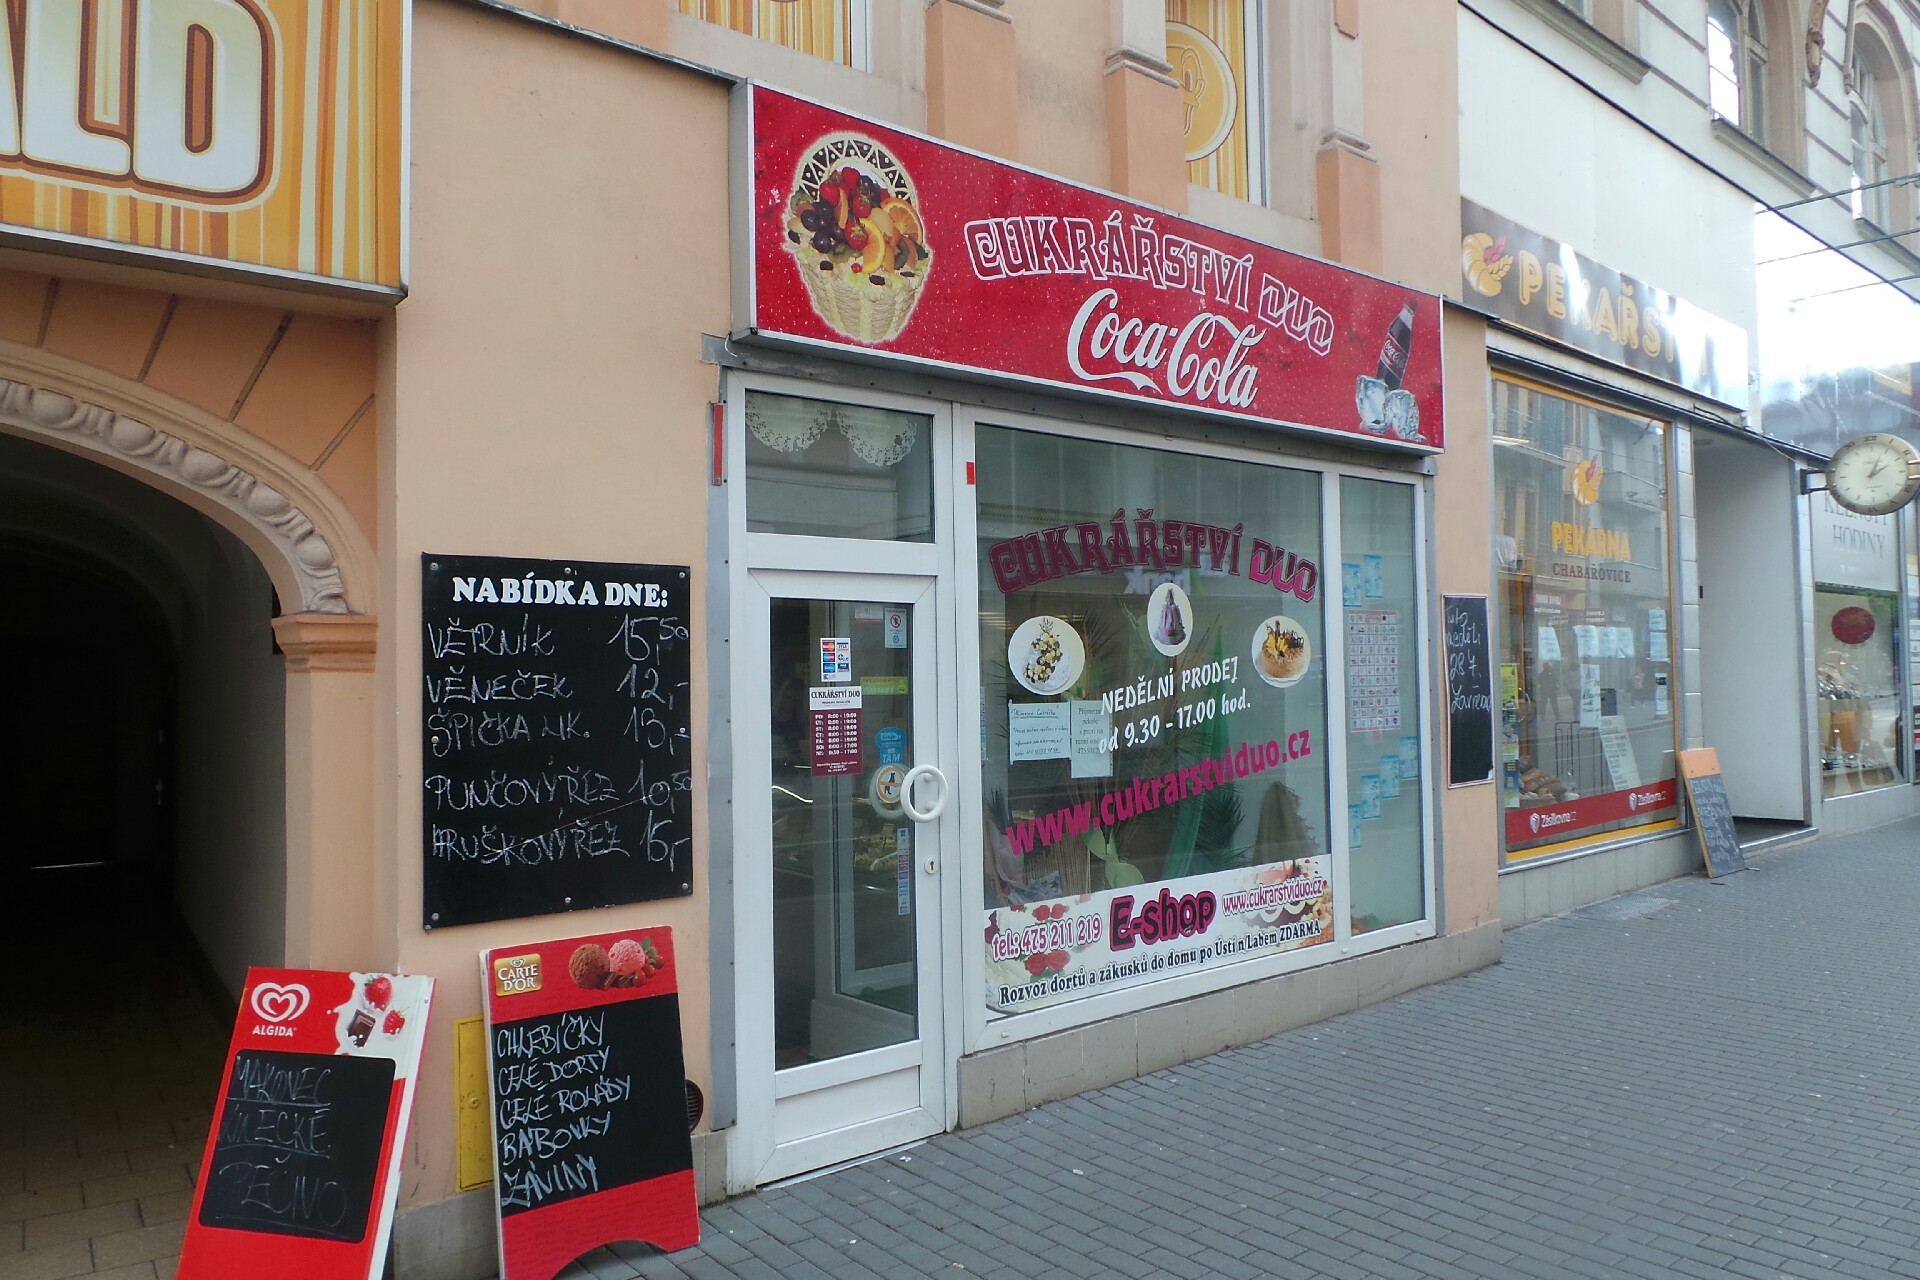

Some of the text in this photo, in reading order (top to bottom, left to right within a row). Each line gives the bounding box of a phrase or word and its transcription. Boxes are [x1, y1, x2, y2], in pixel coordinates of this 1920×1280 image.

[964, 210, 1334, 357] CUKRÁŘSTVÍ DUO
[1518, 249, 1710, 377] PEKAŘST
[1067, 288, 1267, 408] Coca-Cola
[988, 508, 1245, 594] CUKRÁŘSTVÍ
[1249, 538, 1319, 603] DUO
[1551, 519, 1632, 561] PEKÁRNA
[1833, 524, 1885, 559] HODINY
[452, 571, 668, 608] NABÍDKA DNE:
[1552, 562, 1632, 583] CHABAŘOVICE
[427, 613, 555, 658] VĚTRNÍK
[426, 665, 573, 704] VĚNEČEK
[811, 689, 860, 699] CUKRÁŘSTVÍ DUO
[1100, 655, 1238, 716] NEDĚLNÍ PRODEJ
[428, 707, 531, 757] ŠPIČKA
[1099, 728, 1120, 755] od
[1125, 713, 1159, 748] 9.30
[1177, 697, 1215, 729] 17.00
[1222, 688, 1251, 714] hod.
[1006, 729, 1311, 857] www.cukrarstviduo.cz
[1222, 877, 1324, 916] www.cukrarstviduo.cz
[992, 916, 1101, 959] tel.: 475 211 219
[1110, 888, 1217, 951] E-shop
[497, 964, 539, 981] CARTE
[503, 976, 537, 992] D'OR
[999, 981, 1048, 1006] Rozvoz
[1050, 972, 1087, 994] dortů
[1089, 972, 1097, 984] a
[1100, 957, 1149, 982] zákusků
[1151, 956, 1165, 971] do
[1167, 949, 1198, 967] domu
[1200, 946, 1213, 964] po
[1215, 937, 1236, 957] Ústí
[1279, 919, 1321, 942] ZDARMA
[252, 1025, 295, 1037] ALGIDA
[499, 1046, 611, 1096] CELÉ DORTY
[500, 1085, 552, 1131] CELÉ
